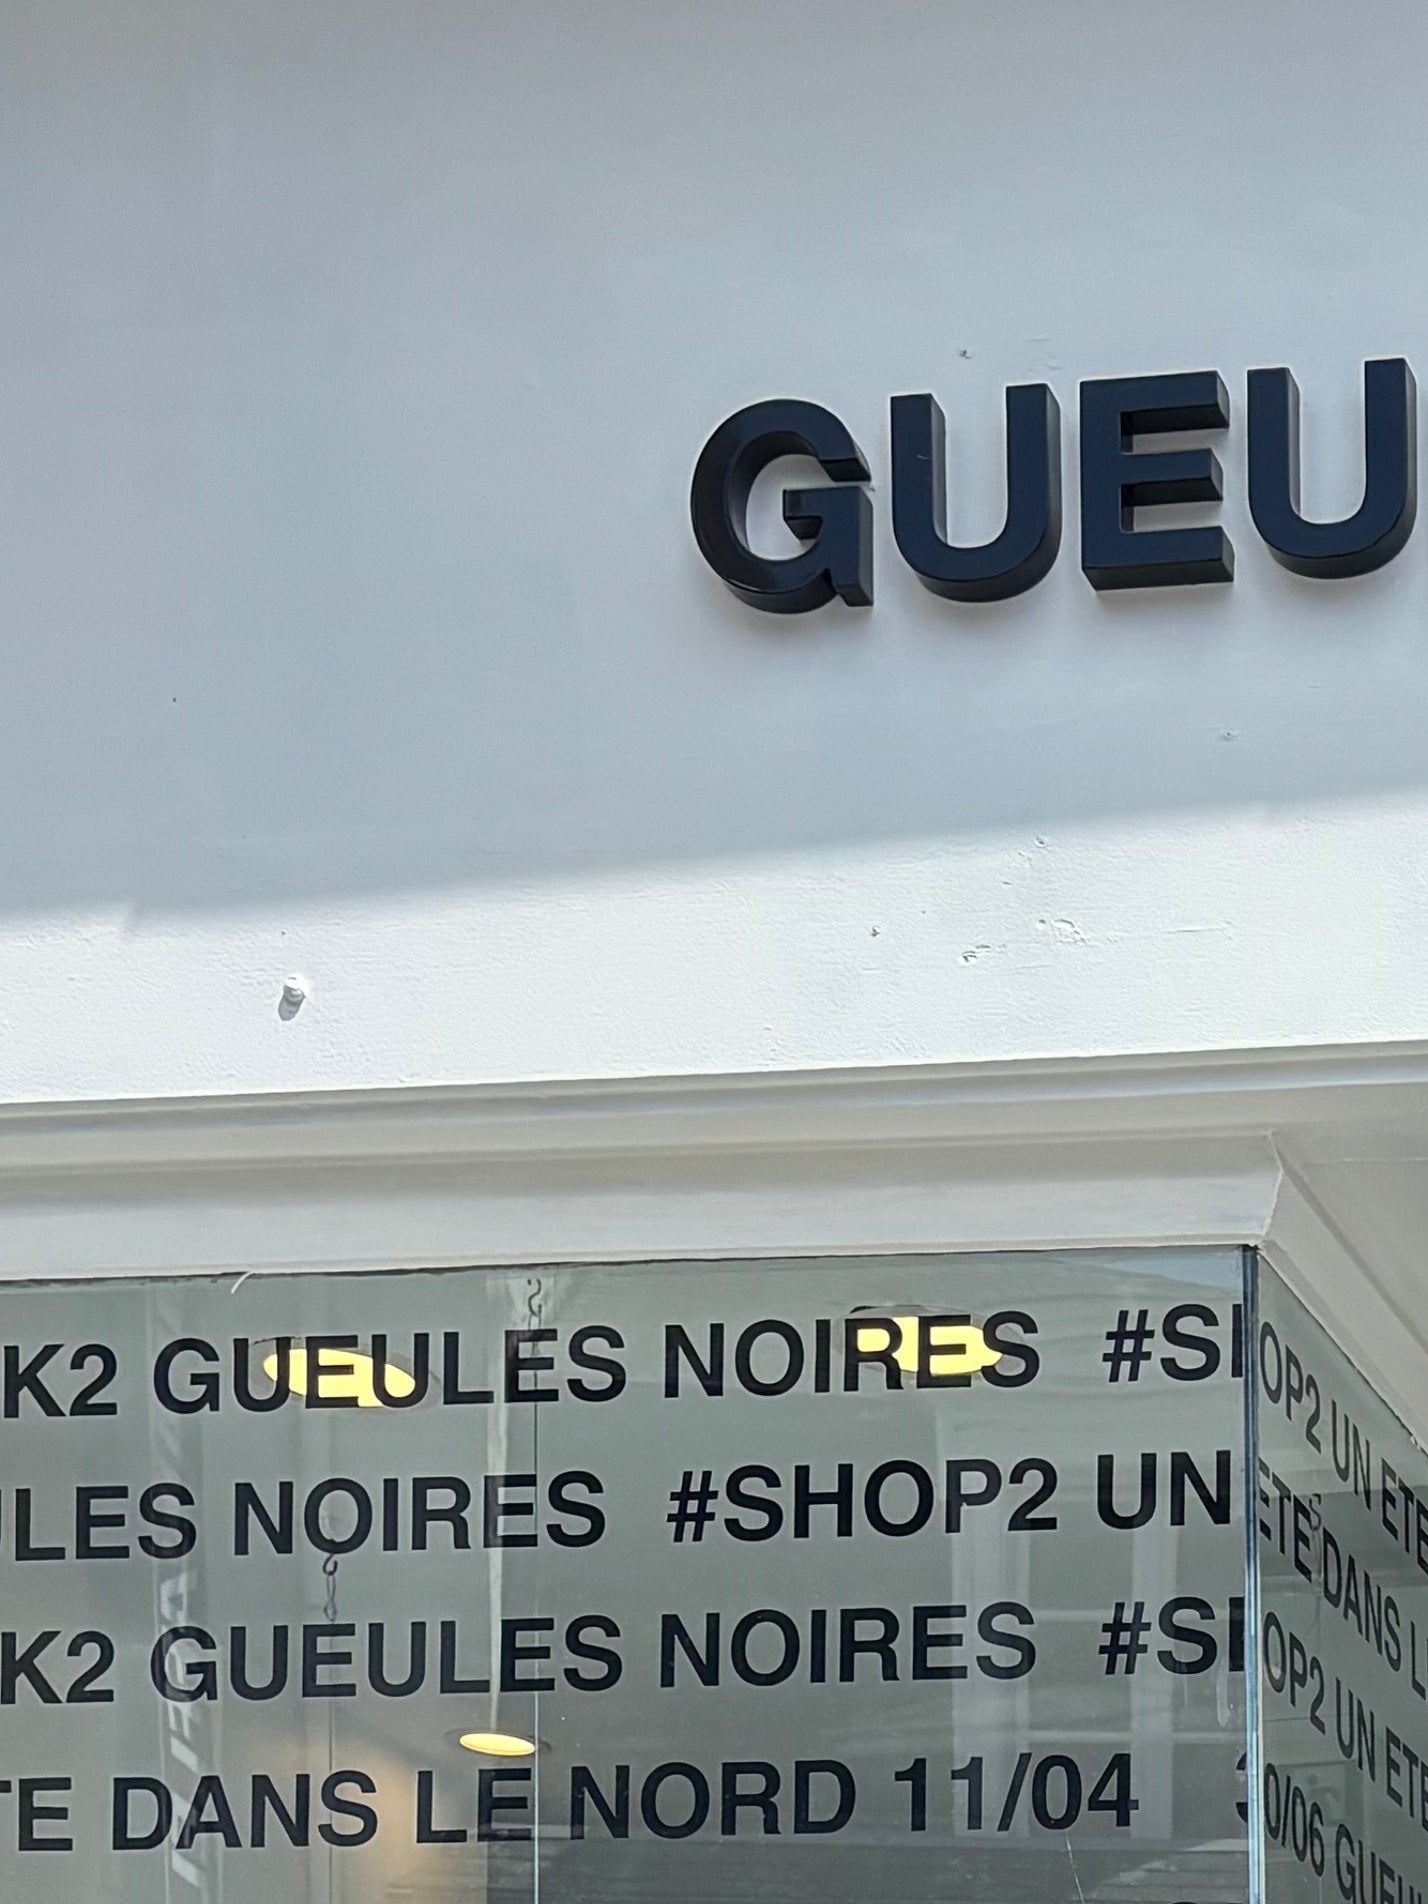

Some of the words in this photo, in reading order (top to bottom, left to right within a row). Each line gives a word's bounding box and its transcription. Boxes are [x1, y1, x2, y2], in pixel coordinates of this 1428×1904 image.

[154, 1325, 626, 1414] GUEULES
[665, 1311, 1040, 1398] NOIRES
[1259, 1322, 1322, 1454] OP2
[1332, 1416, 1372, 1508] UN
[234, 1470, 605, 1555] NOIRES
[667, 1458, 1058, 1543] #SHOP2
[1097, 1450, 1232, 1529] UN
[150, 1614, 622, 1701] GUEULES
[660, 1601, 1036, 1688] NOIRES
[1322, 1521, 1400, 1672] DANS
[1263, 1612, 1326, 1738] OP2
[1336, 1678, 1376, 1783] UN
[112, 1771, 378, 1850] DANS
[417, 1768, 533, 1843] LE
[570, 1760, 856, 1841] NORD
[895, 1753, 1139, 1832] 11/04
[1263, 1761, 1325, 1878] 0/06
